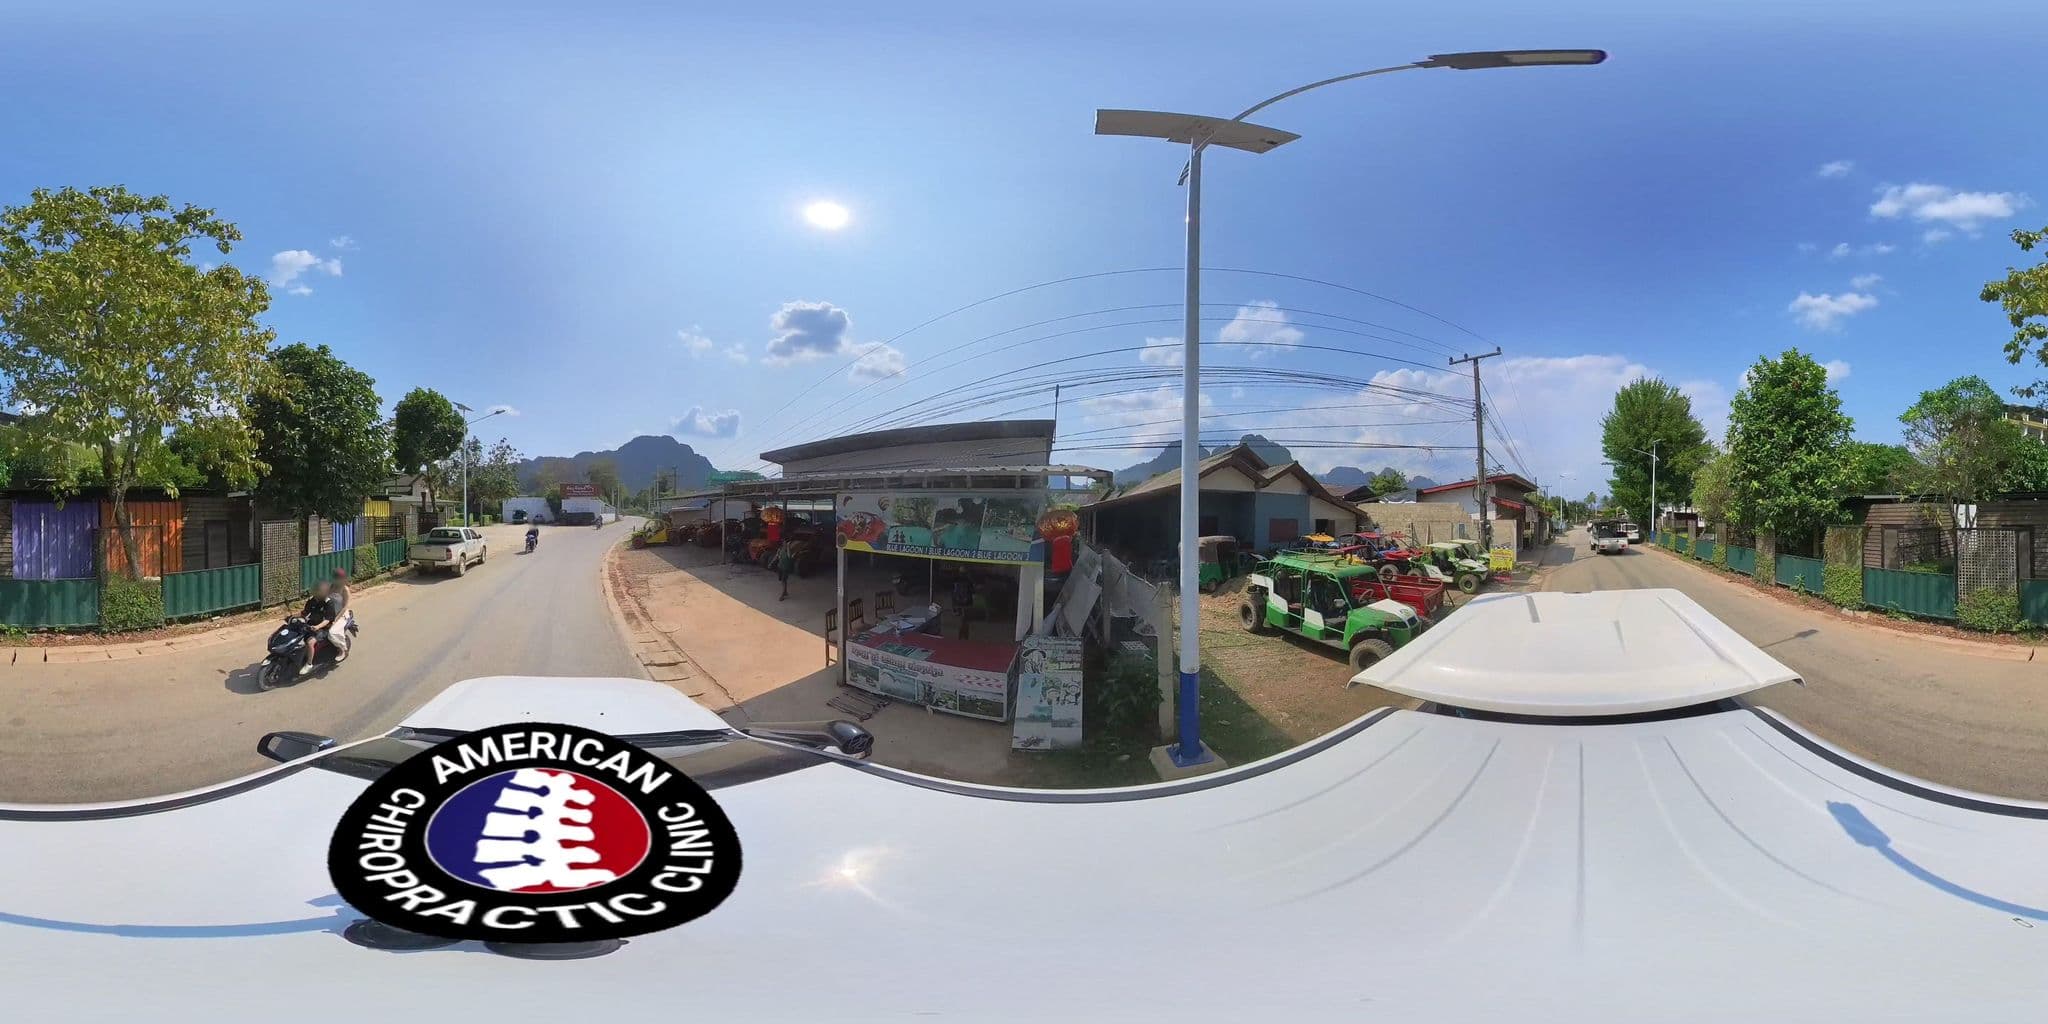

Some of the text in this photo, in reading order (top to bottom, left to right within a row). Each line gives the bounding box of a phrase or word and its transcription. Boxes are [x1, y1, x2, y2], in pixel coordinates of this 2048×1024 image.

[900, 544, 923, 554] LAGOON
[928, 547, 942, 556] BLUE
[943, 548, 970, 558] LAGOON
[977, 550, 992, 560] BLUE
[993, 551, 1023, 561] LAGOON
